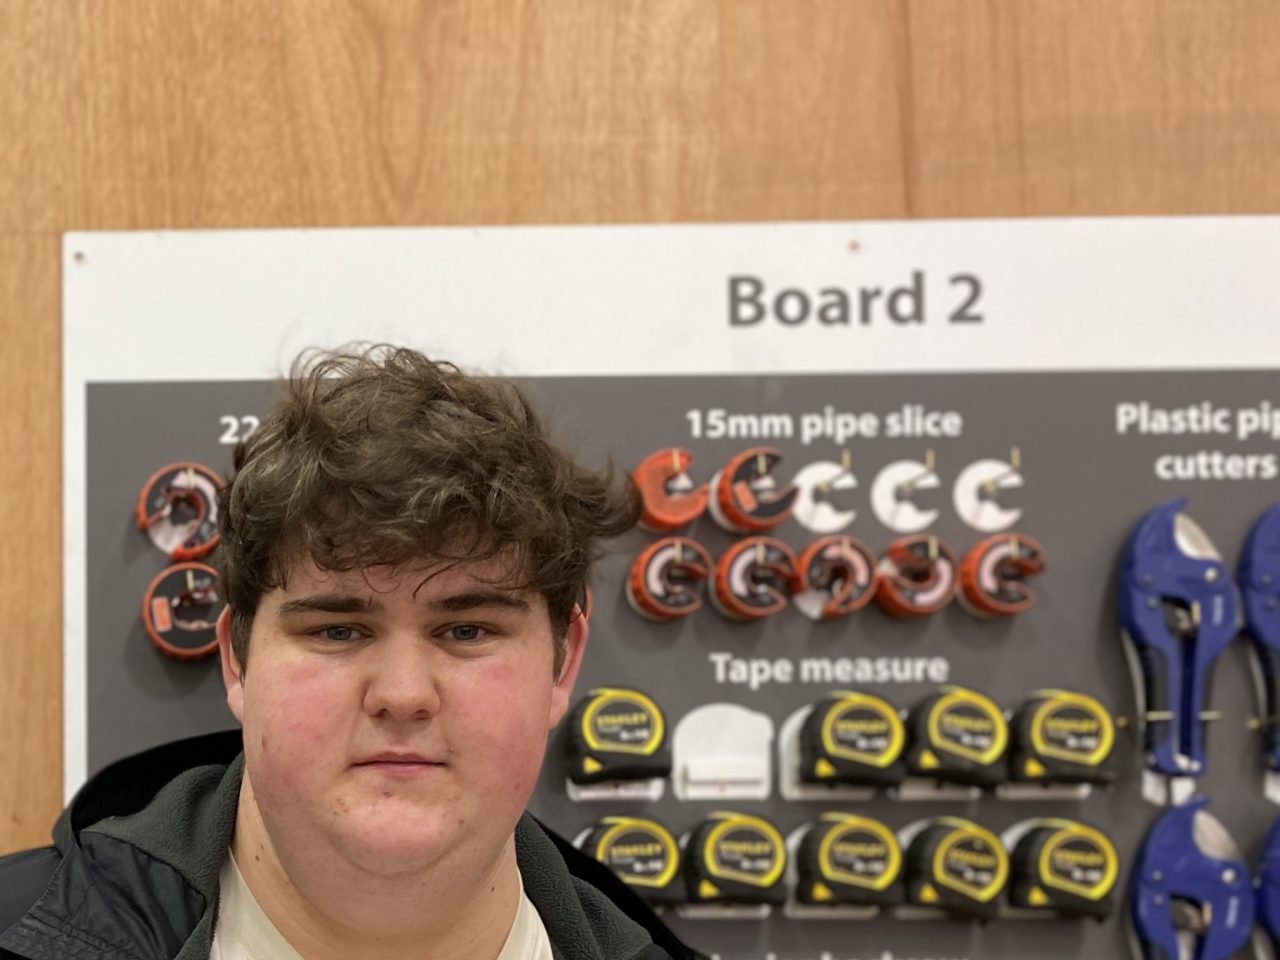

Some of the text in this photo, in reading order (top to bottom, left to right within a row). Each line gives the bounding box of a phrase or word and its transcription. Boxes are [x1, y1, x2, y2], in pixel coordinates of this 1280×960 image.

[728, 271, 985, 328] Board 2
[686, 405, 963, 444] 15mm pipe slice
[1116, 402, 1230, 434] Plastic
[1155, 451, 1278, 480] cutters
[710, 653, 949, 690] Tape measure
